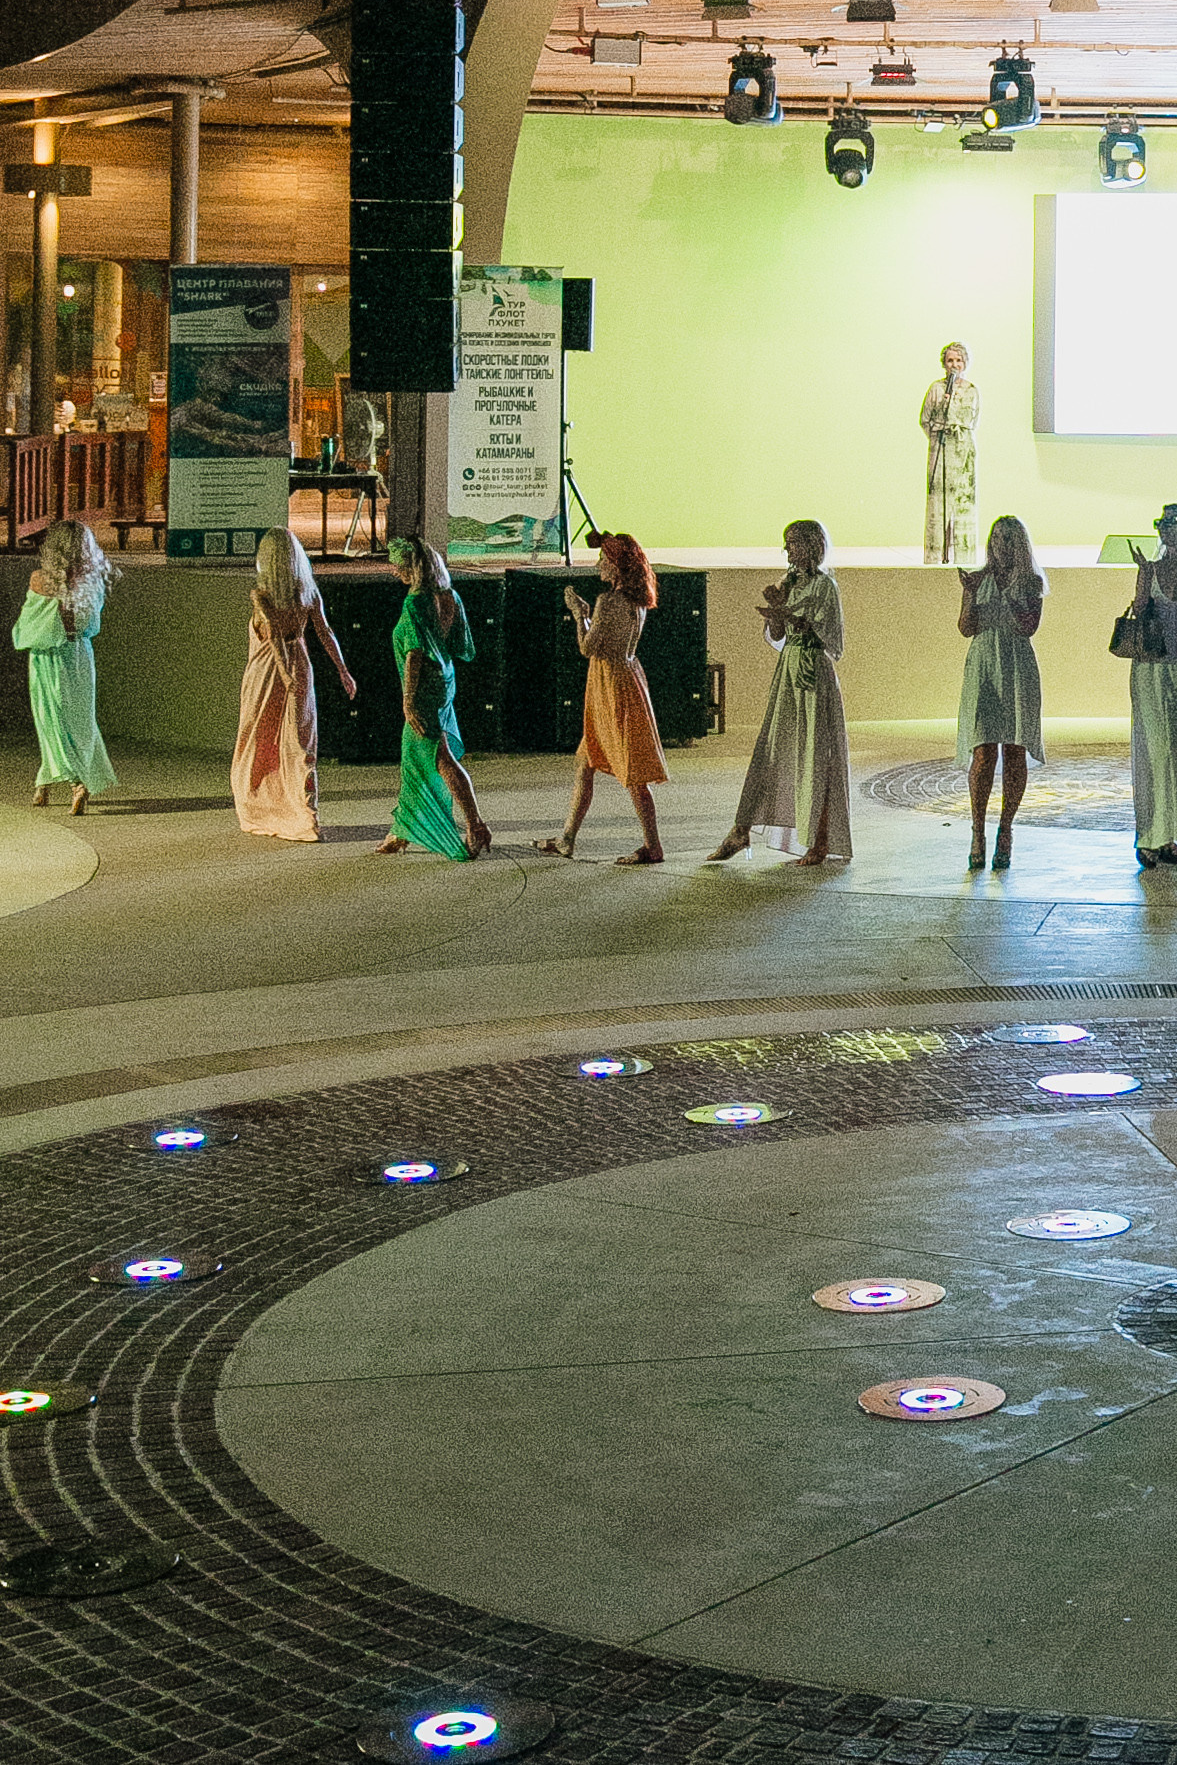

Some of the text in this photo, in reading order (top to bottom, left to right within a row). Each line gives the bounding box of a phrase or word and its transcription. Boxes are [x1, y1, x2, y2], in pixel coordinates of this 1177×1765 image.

[176, 279, 284, 289] ЦЕНТР ПЛАВАНИЯ
[507, 301, 526, 309] ТУР
[497, 310, 526, 318] ФЛОТ
[488, 319, 526, 327] ПХУКЕТ
[463, 354, 550, 366] СКОРОСТНЫЕ ЛОДКИ
[465, 368, 502, 379] ТАЙСКИЕ
[504, 368, 554, 380] ЛОНГТЕЙЛЫ
[479, 386, 525, 397] РЫБАЦКИЕ
[474, 400, 537, 411] ПРОГУЛОЧНЫЕ
[489, 414, 522, 426] КАТЕРА
[489, 433, 521, 445] ЯХТЫ И
[476, 447, 535, 459] КАТАМАРАНЫ
